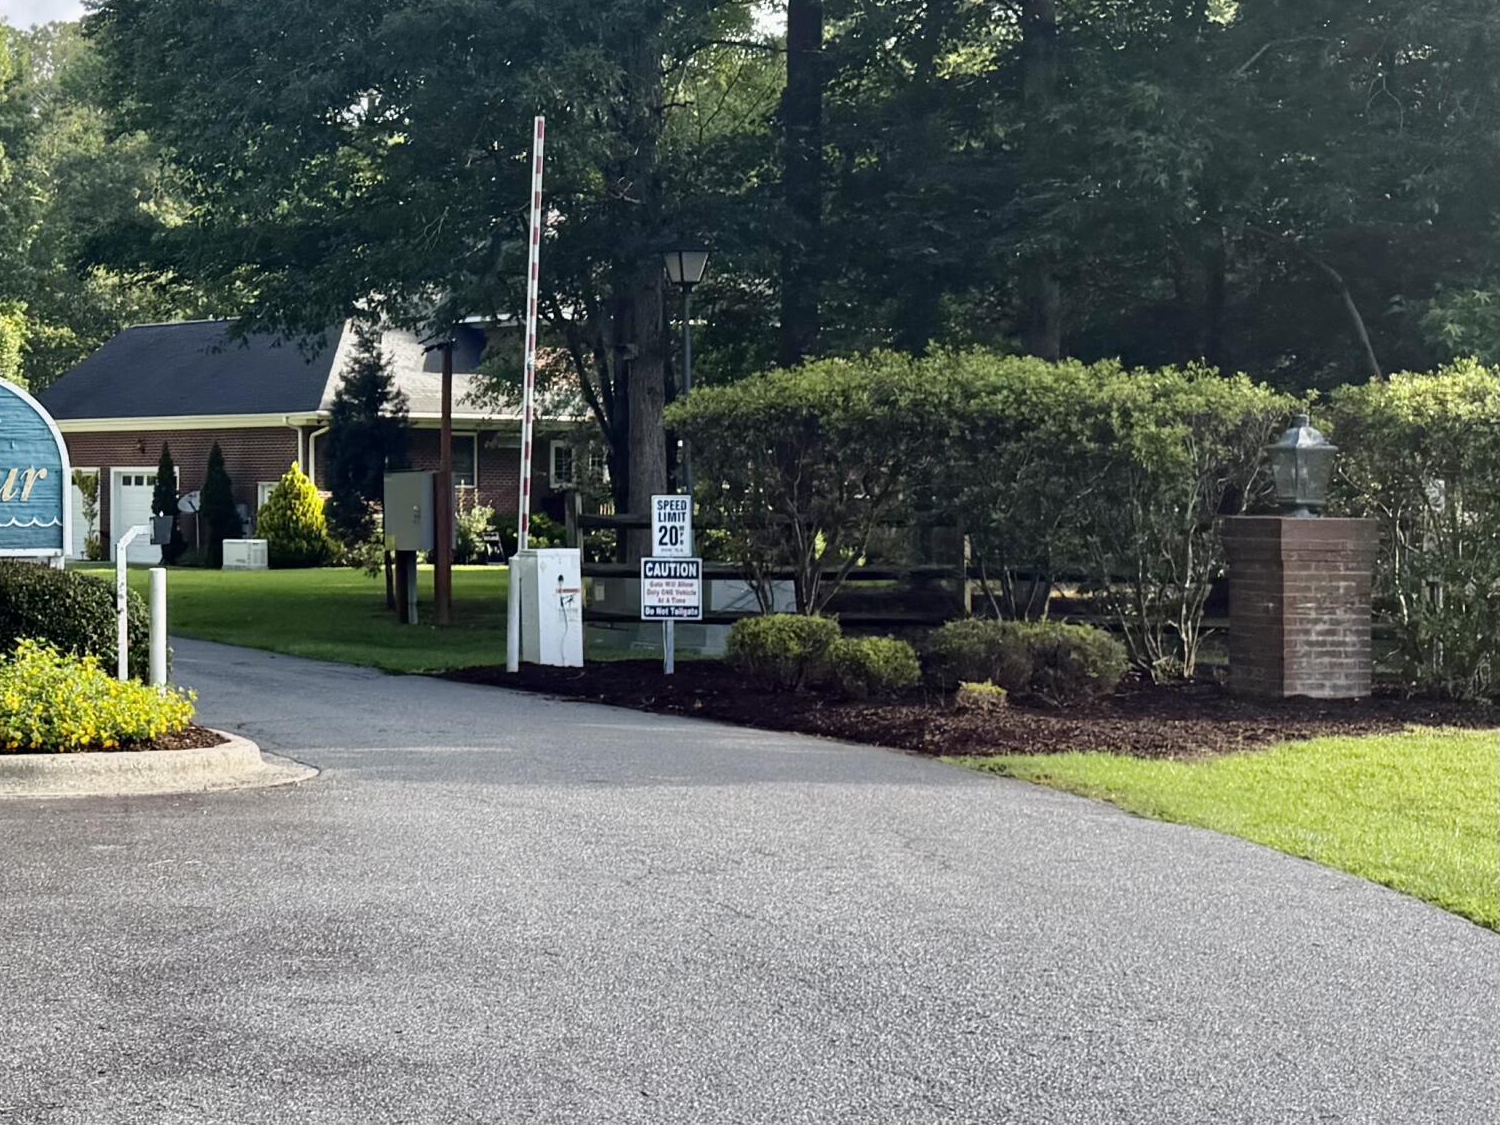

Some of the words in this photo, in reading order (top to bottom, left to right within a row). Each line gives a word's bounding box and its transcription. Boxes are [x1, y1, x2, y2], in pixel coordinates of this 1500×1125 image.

[657, 500, 687, 511] SPEED
[658, 512, 687, 523] LIMIT
[658, 525, 679, 547] 20
[645, 562, 697, 577] CAUTION
[645, 607, 655, 615] Do
[656, 607, 669, 615] Not
[670, 607, 698, 617] Tailgate
